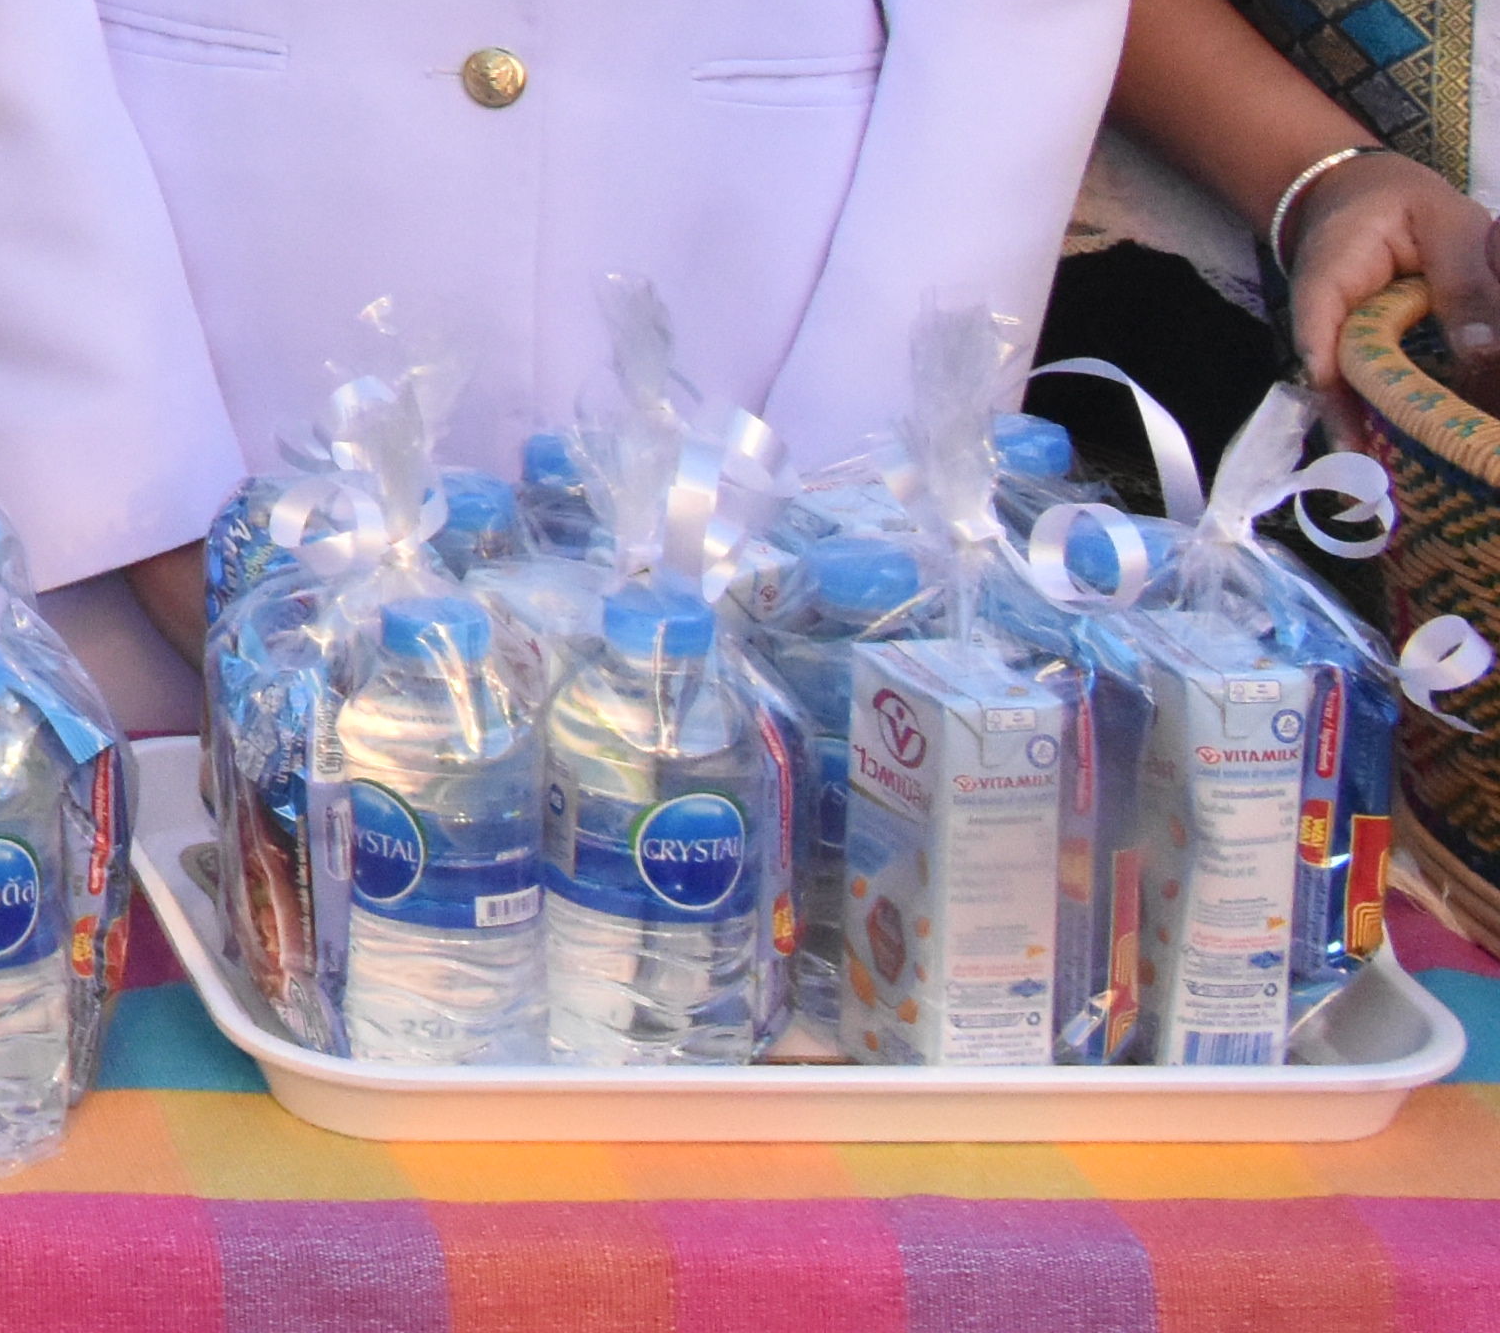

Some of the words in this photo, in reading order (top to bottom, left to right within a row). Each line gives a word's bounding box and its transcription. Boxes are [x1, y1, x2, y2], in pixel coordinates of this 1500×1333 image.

[1223, 749, 1299, 764] VITAMILK
[355, 830, 418, 863] YSTAL
[642, 836, 740, 863] CRYSTAL
